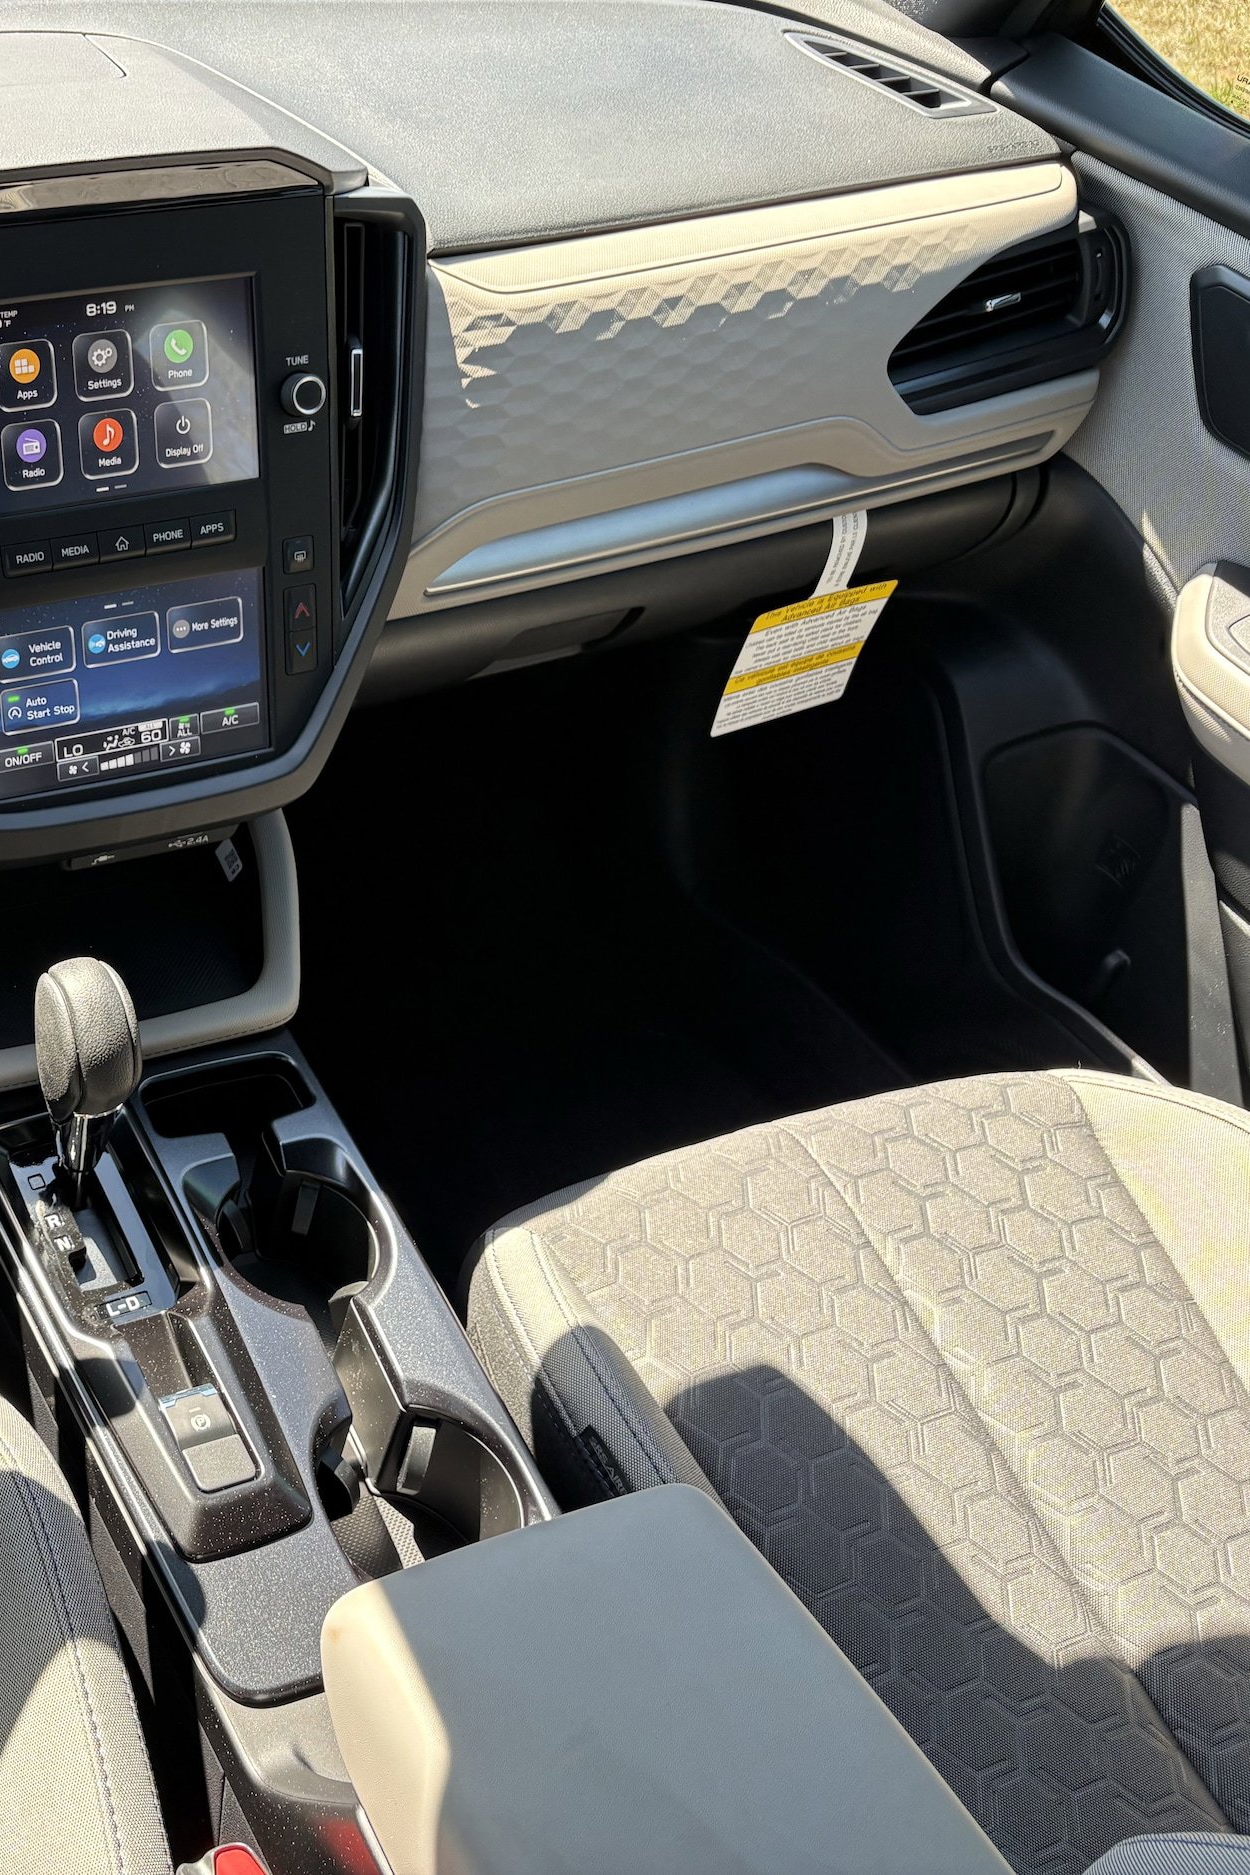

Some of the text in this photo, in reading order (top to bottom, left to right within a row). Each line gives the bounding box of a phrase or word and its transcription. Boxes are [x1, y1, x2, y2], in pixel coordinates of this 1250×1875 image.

[0, 310, 18, 320] TEMP
[85, 301, 117, 317] 8:19
[286, 354, 309, 366] TUNE
[168, 368, 193, 379] Phone
[87, 378, 122, 390] Settings
[16, 389, 39, 400] Apps
[284, 422, 308, 434] HOLD
[165, 444, 204, 458] Display Off
[98, 456, 122, 468] Media
[22, 468, 46, 479] Radio
[200, 522, 225, 535] APPS
[152, 529, 184, 543] PHONE
[61, 544, 90, 557] MEDIA
[15, 551, 45, 564] RADIO
[191, 615, 239, 632] More Settings
[106, 627, 138, 641] Driving
[28, 639, 61, 653] Vehicle
[107, 637, 156, 653] Assistance
[29, 653, 64, 667] Control
[25, 696, 47, 708] Auto
[26, 703, 75, 721] Start Stop
[221, 714, 239, 727] A/C
[121, 726, 136, 737] A/C
[177, 728, 193, 738] ALL
[63, 729, 162, 758] LO 60
[4, 751, 43, 768] ON/OFF
[186, 834, 210, 846] 2.4A
[44, 1213, 62, 1229] R
[54, 1235, 73, 1252] N
